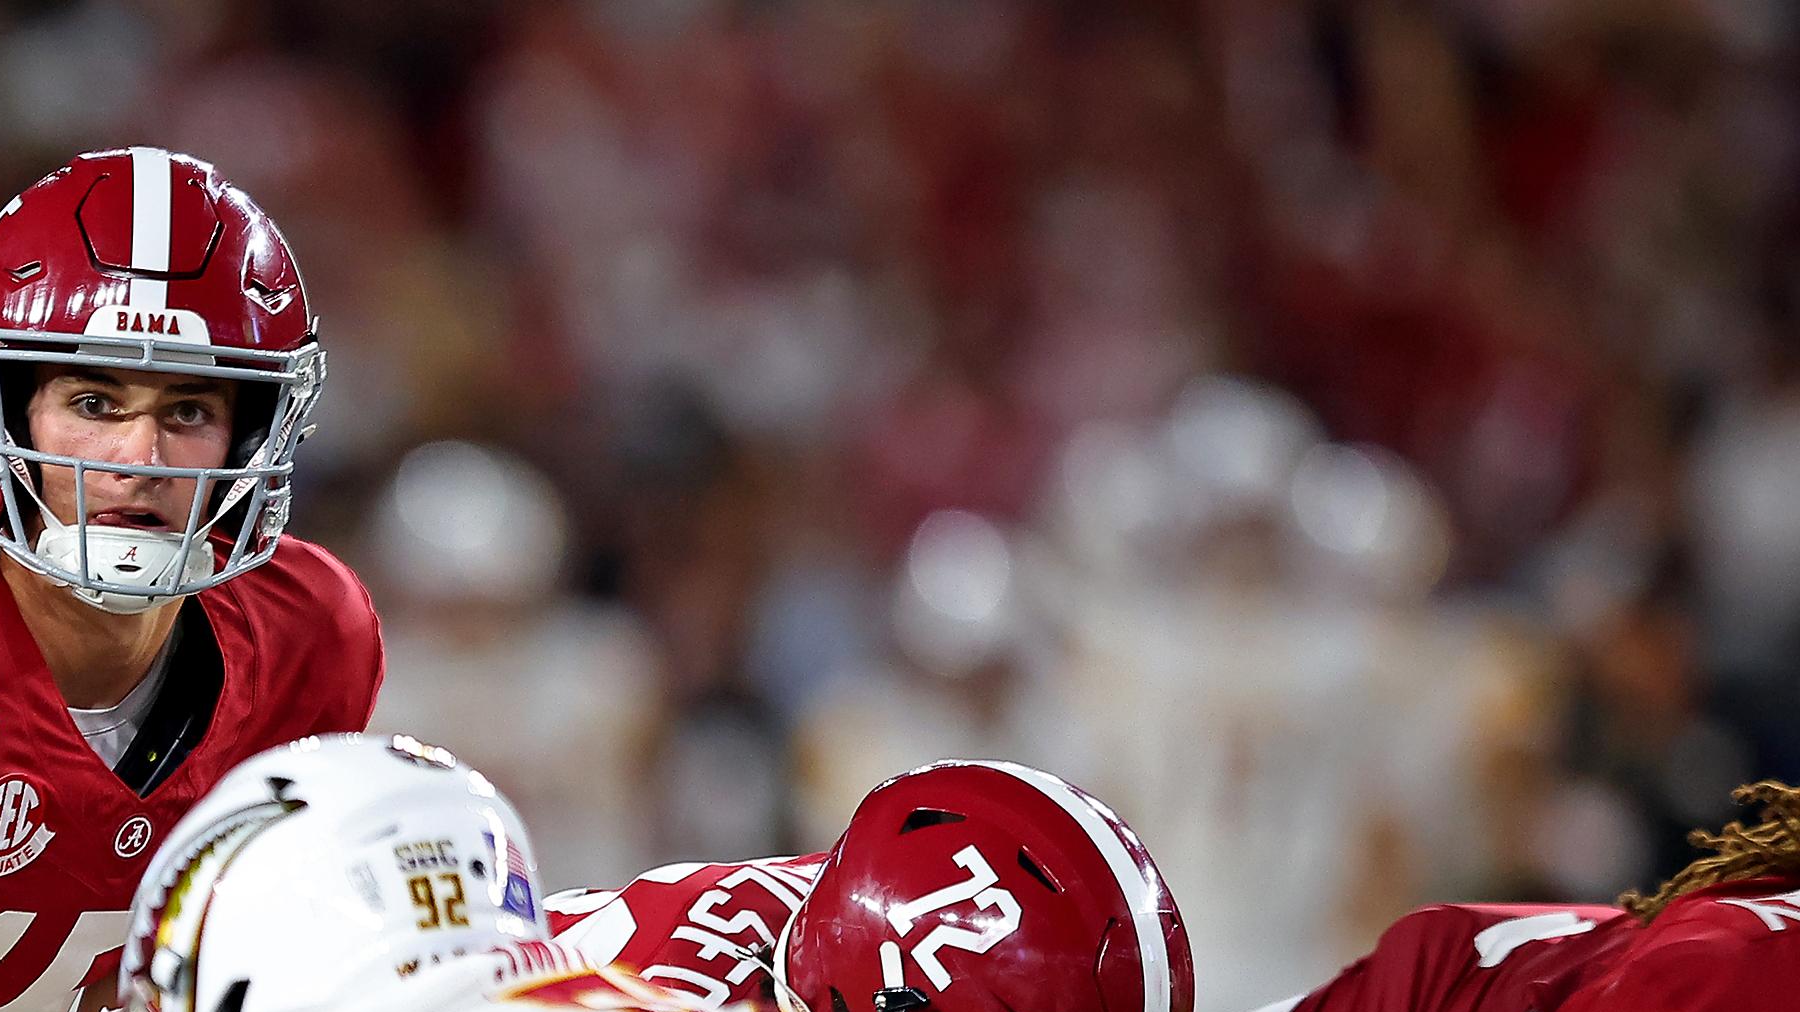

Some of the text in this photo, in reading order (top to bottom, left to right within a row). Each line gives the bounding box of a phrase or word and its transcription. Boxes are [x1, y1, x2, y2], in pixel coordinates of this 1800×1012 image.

[115, 310, 181, 336] BAMA
[118, 545, 138, 562] A
[118, 822, 145, 851] A
[406, 873, 470, 929] 92
[885, 844, 1023, 993] 72
